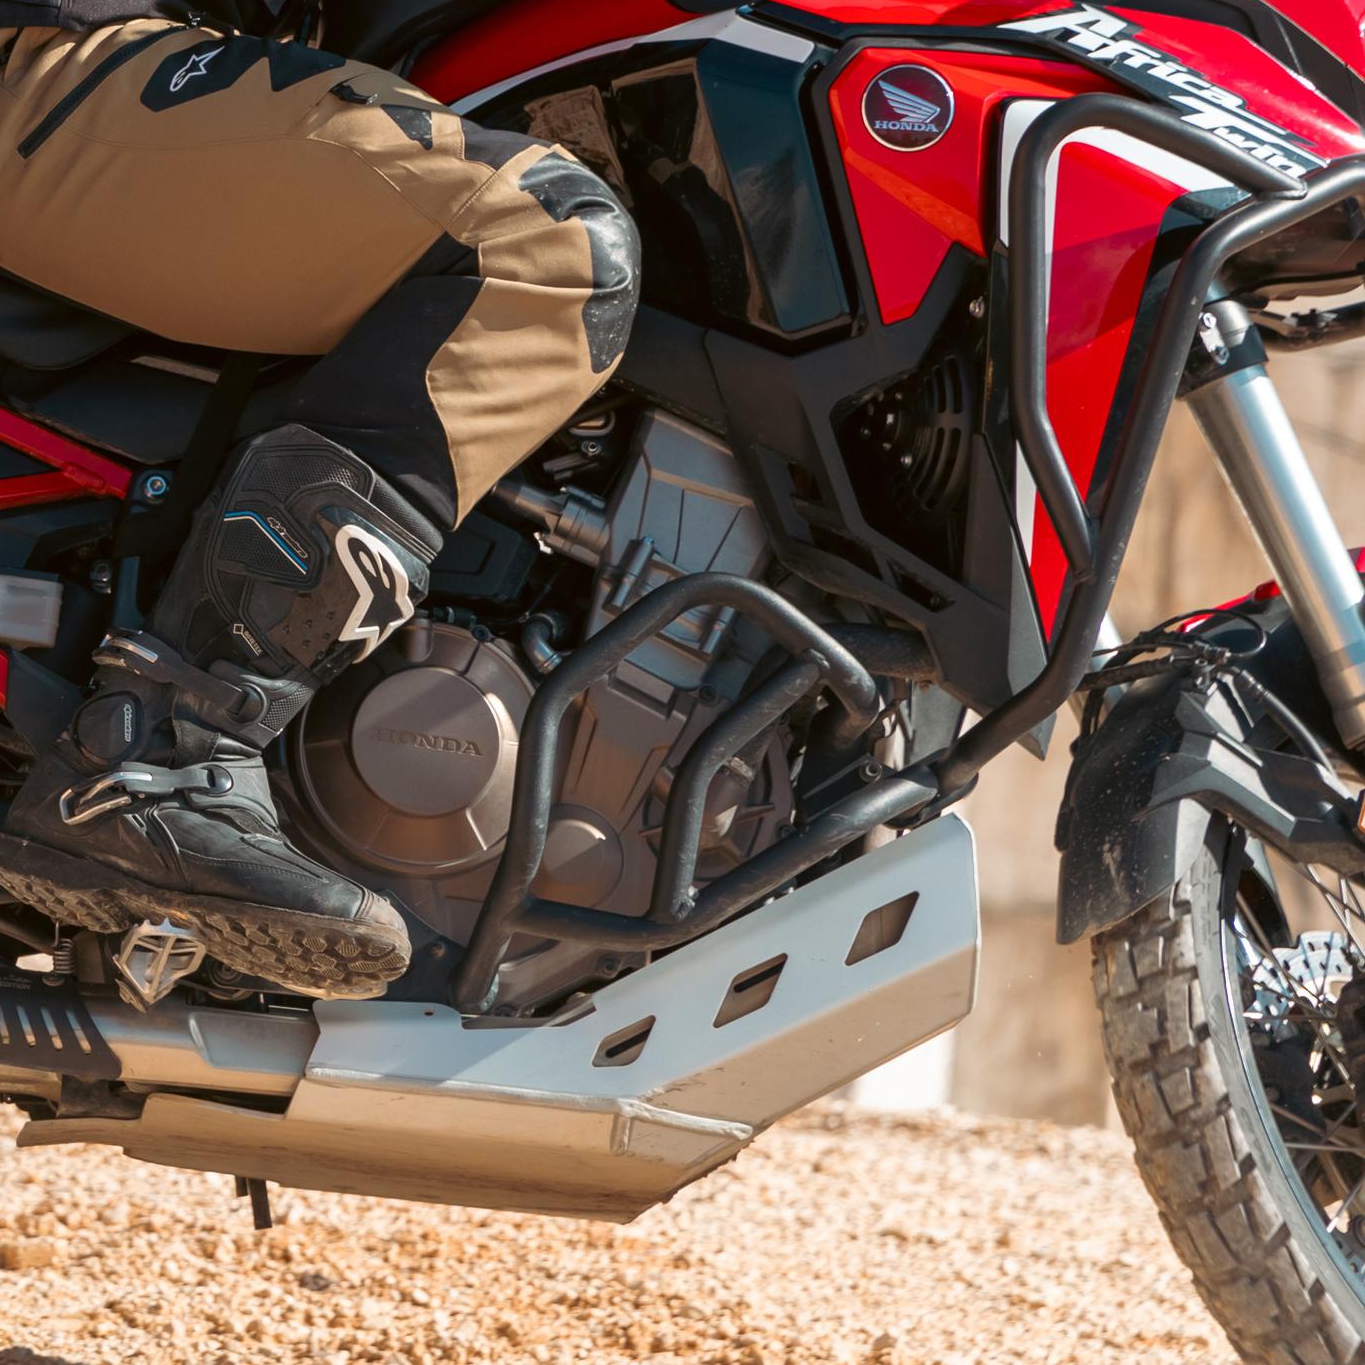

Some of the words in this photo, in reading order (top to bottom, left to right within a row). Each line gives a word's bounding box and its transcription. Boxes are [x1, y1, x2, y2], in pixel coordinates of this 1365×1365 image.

[997, 3, 1287, 135] Africa
[874, 119, 939, 134] HONDA
[373, 729, 485, 756] HONDA
